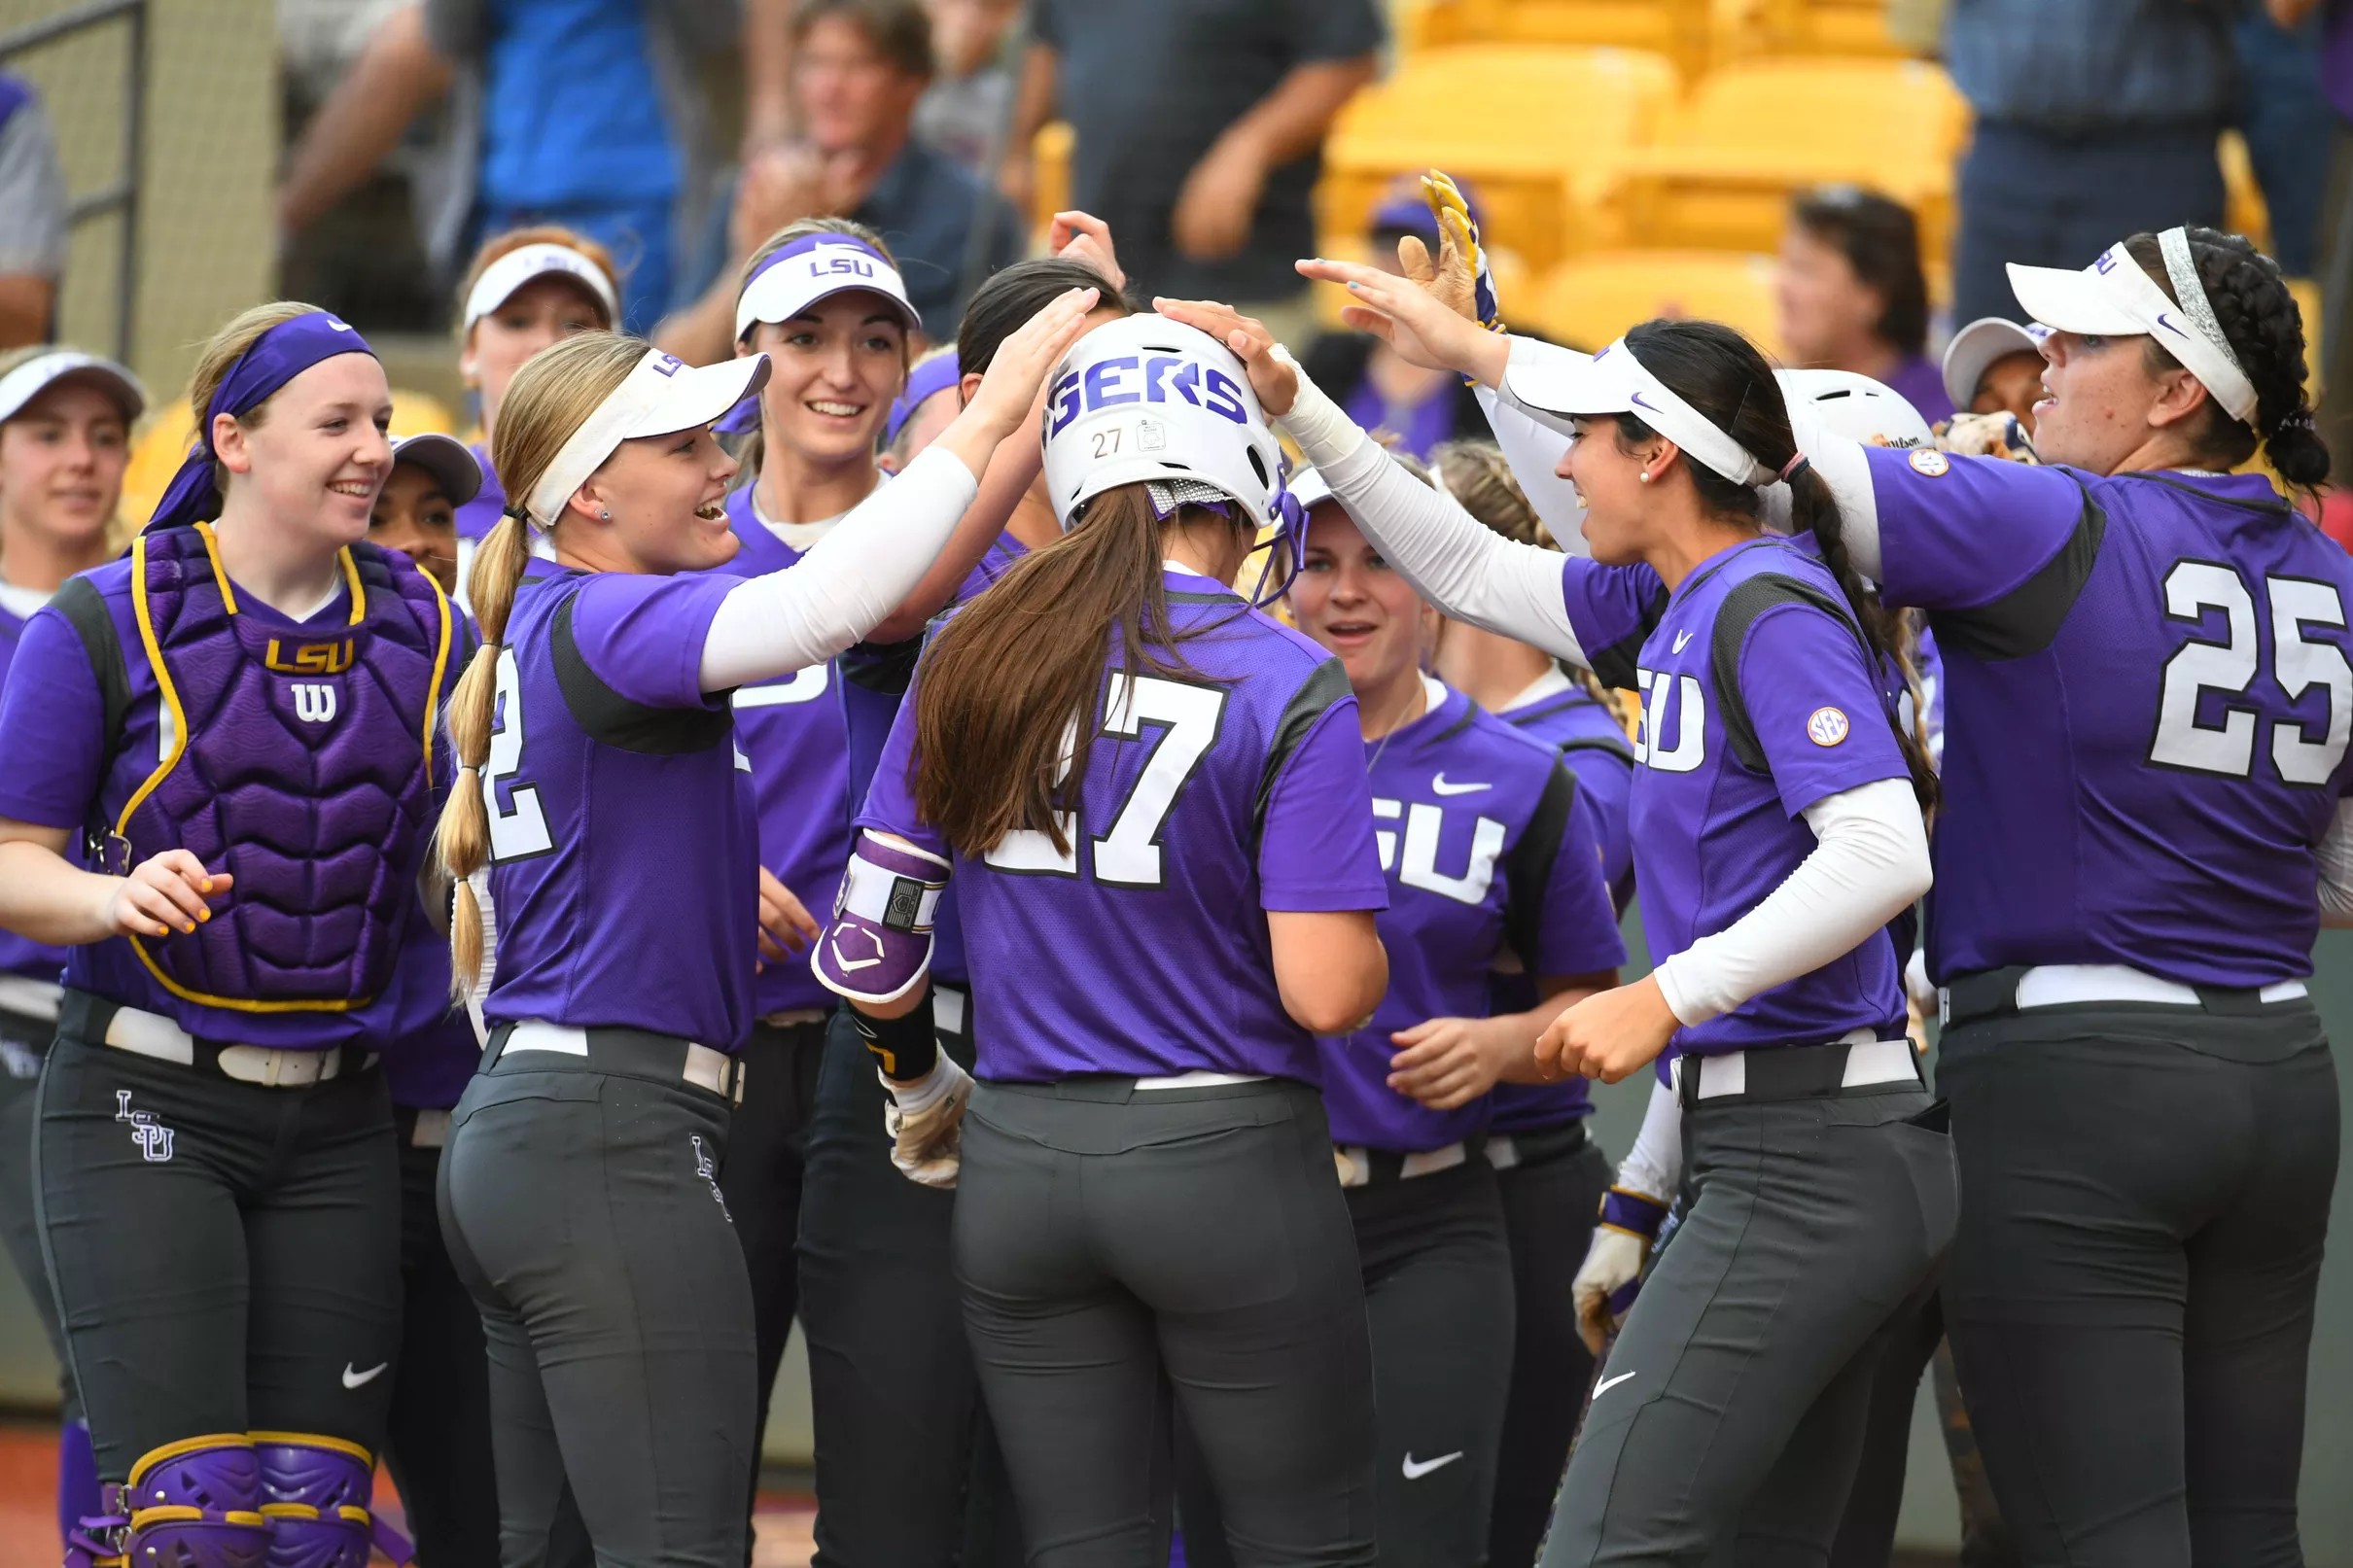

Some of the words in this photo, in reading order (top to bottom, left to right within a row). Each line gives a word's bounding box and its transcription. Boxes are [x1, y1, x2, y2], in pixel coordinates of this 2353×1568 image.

[810, 259, 874, 278] LSU
[652, 352, 685, 378] LS
[1044, 356, 1247, 443] GERS
[1092, 428, 1121, 460] 27
[265, 638, 354, 674] LSU
[2145, 558, 2353, 788] 25
[476, 644, 558, 867] 2
[116, 1090, 174, 1162] LSU
